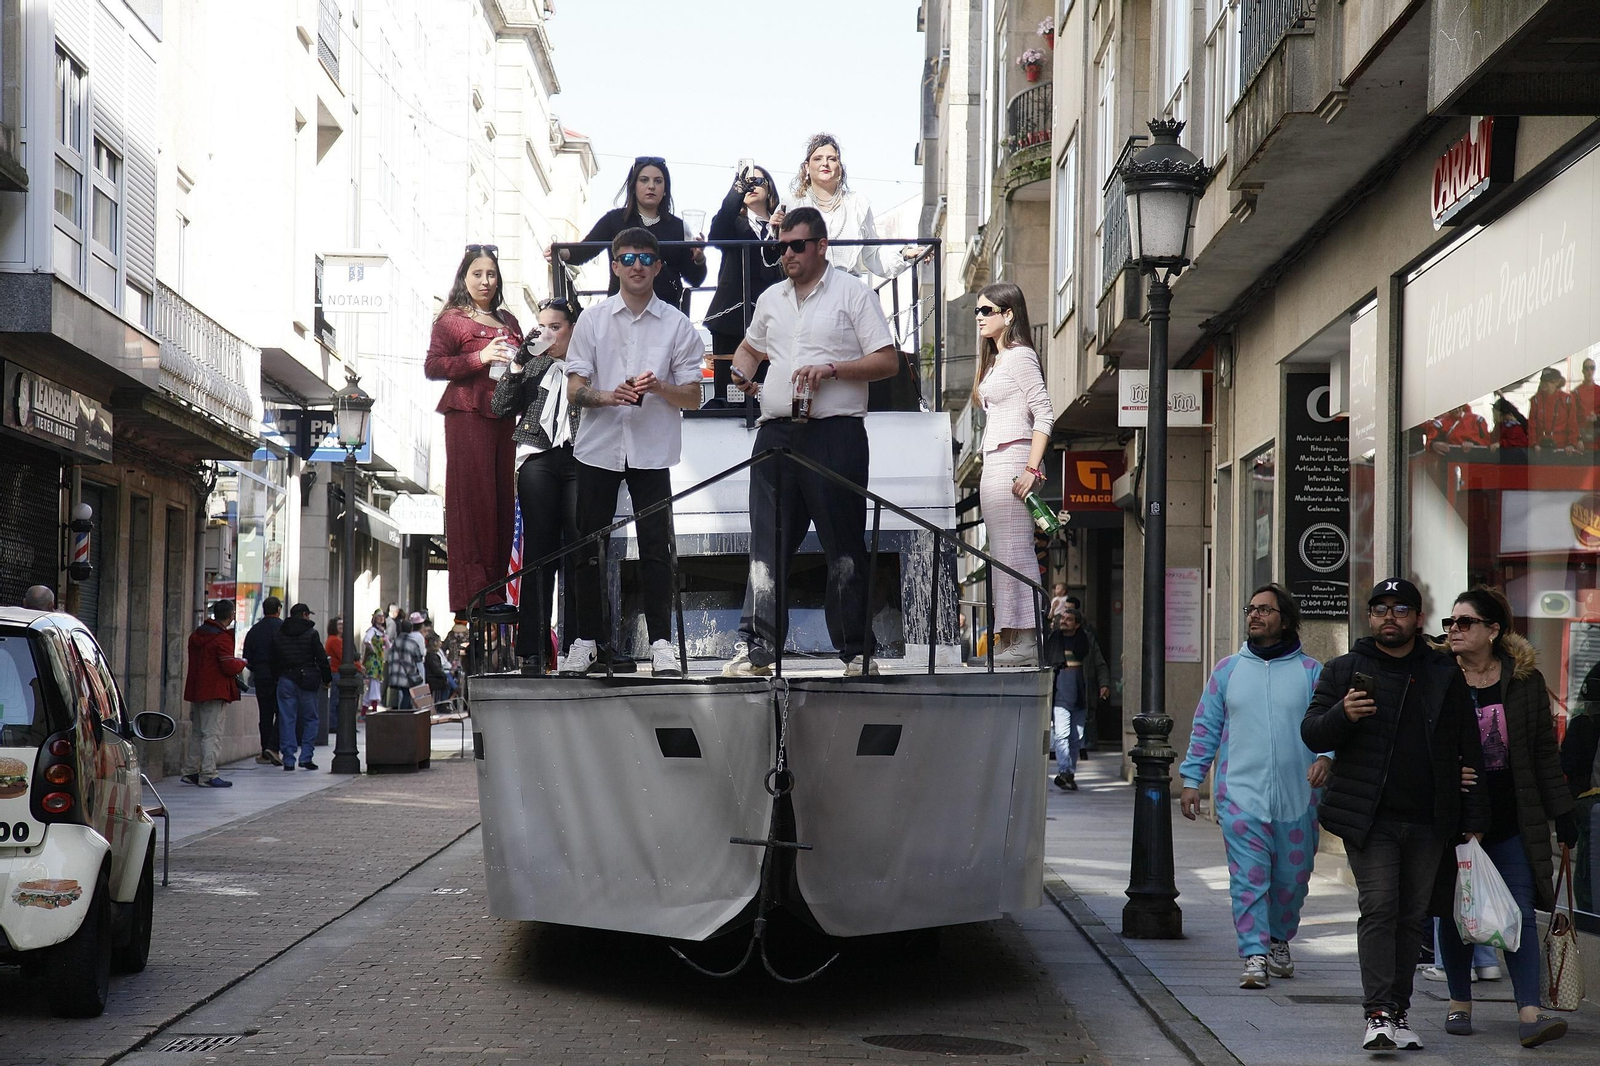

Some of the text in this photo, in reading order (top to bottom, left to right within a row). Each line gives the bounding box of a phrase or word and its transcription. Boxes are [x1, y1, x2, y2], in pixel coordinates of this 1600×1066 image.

[1426, 221, 1576, 368] Líderes en Papelería
[328, 295, 382, 306] NOTARIO
[34, 381, 79, 424] LEADERSHIP
[1333, 464, 1349, 474] Rega
[393, 509, 438, 519] DENTAL
